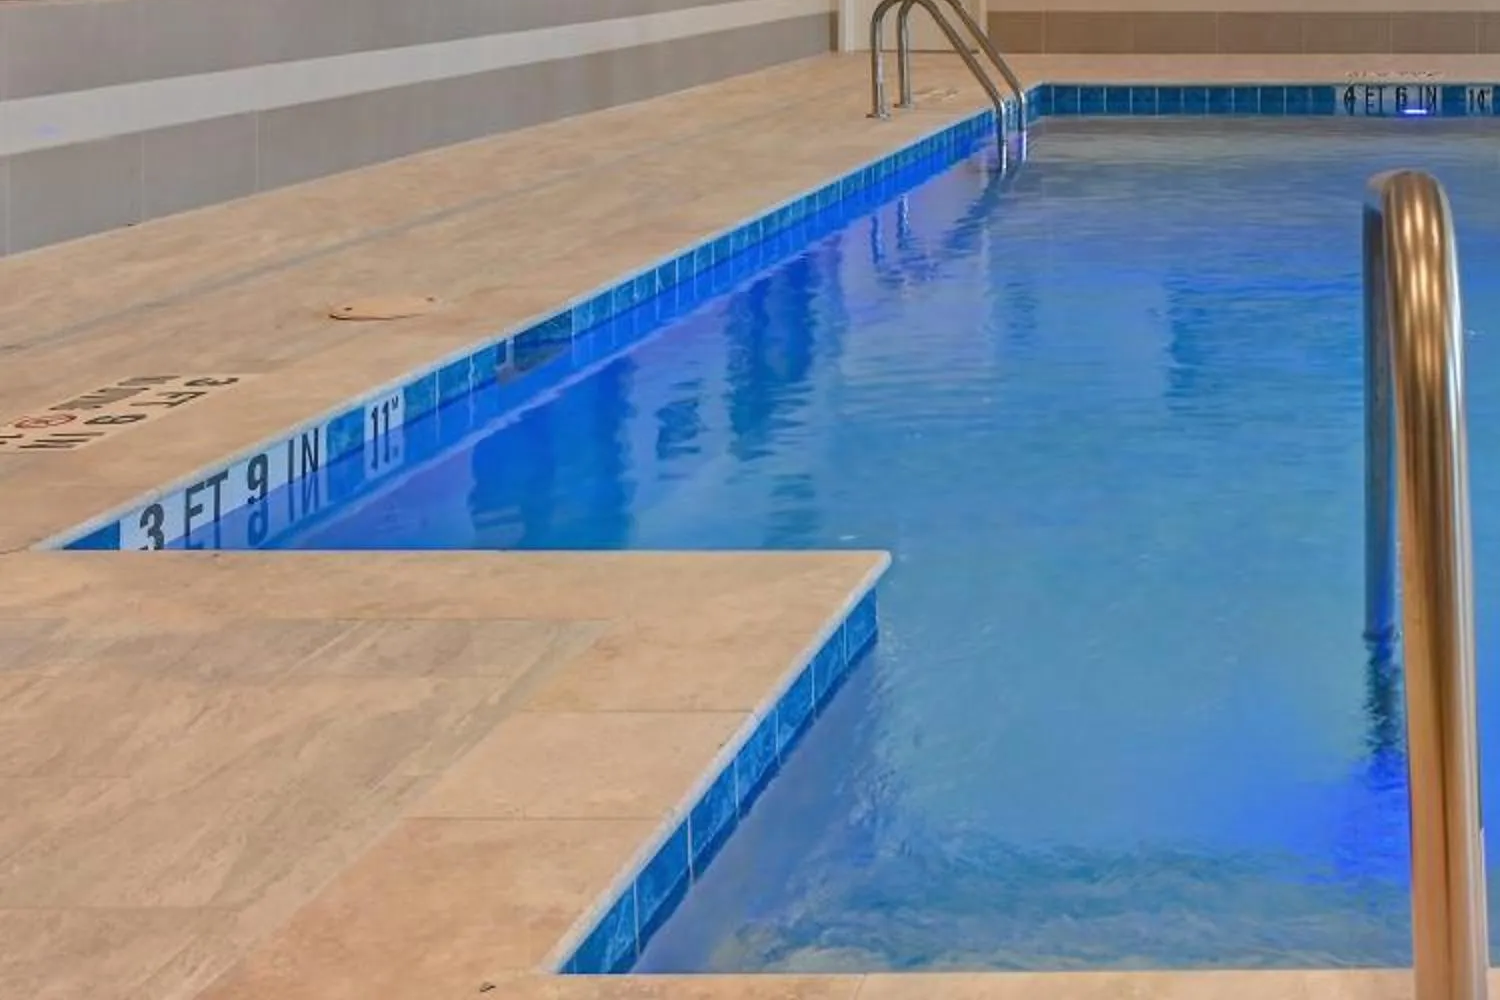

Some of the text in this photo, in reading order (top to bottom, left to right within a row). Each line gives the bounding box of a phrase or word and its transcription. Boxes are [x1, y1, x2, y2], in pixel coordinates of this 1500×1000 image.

[139, 503, 165, 550] 3
[184, 469, 229, 537] FT
[247, 453, 270, 505] 9
[287, 427, 319, 485] IN
